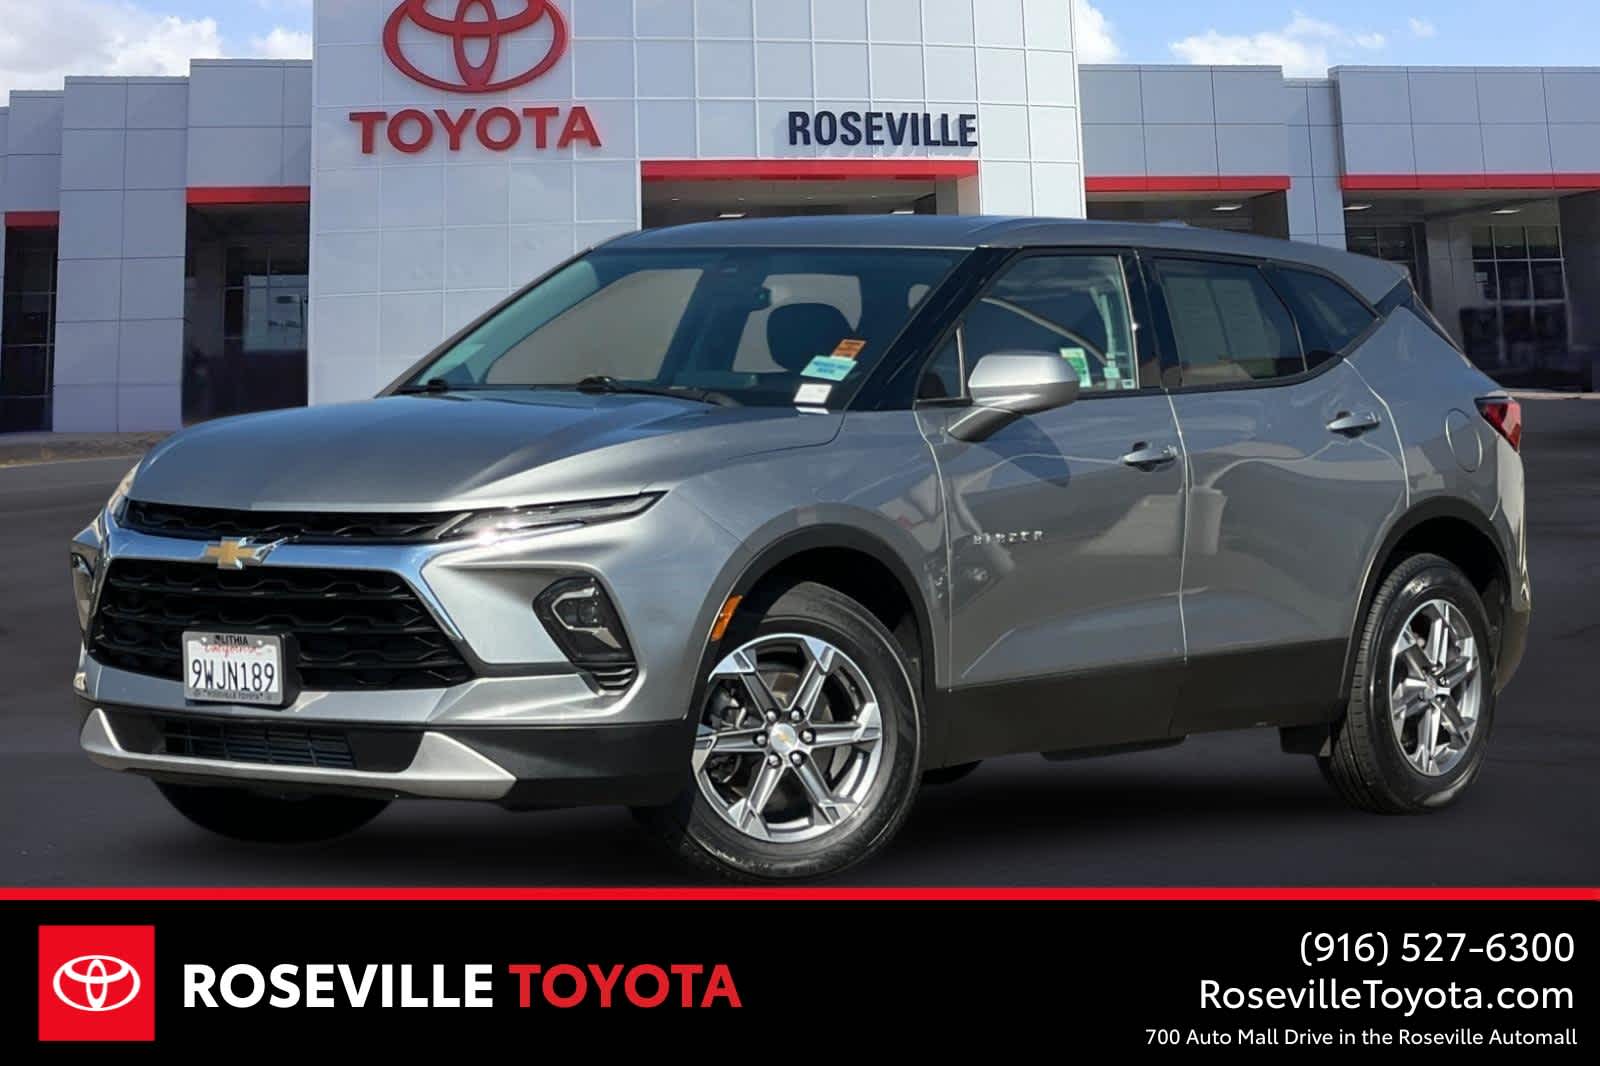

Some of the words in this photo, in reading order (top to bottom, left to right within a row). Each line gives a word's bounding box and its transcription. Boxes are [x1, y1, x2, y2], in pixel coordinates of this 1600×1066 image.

[350, 106, 602, 154] TOYOTA
[788, 110, 978, 147] ROSEVILLE
[192, 659, 275, 692] 9WJN189
